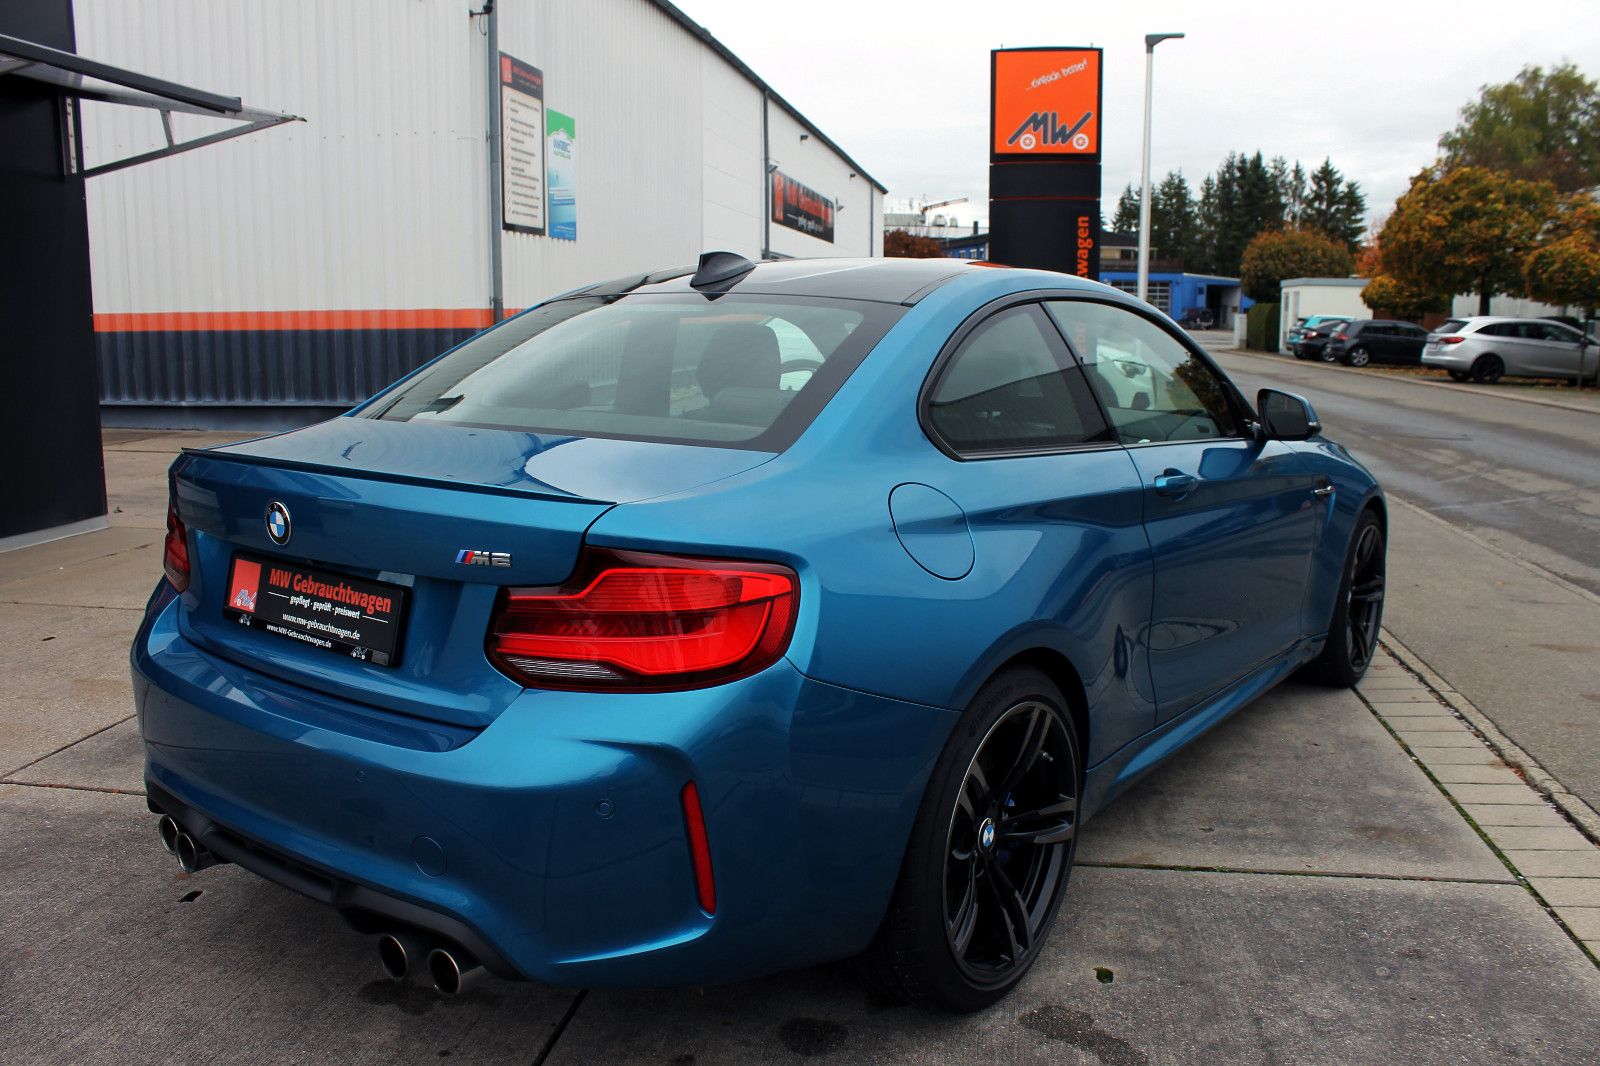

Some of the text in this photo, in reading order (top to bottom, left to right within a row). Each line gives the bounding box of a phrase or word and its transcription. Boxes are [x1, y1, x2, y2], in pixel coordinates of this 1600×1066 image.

[1007, 111, 1092, 146] MW
[1077, 215, 1093, 279] wagen
[470, 550, 511, 567] M2
[269, 568, 392, 614] MW Gebrauchtwagen
[289, 595, 360, 620] gepflegt geprüft preiswert
[266, 623, 332, 649] www.MW-Gebrauchtwagen.de
[282, 612, 360, 640] www.mw-gebrauchtwagen.de
